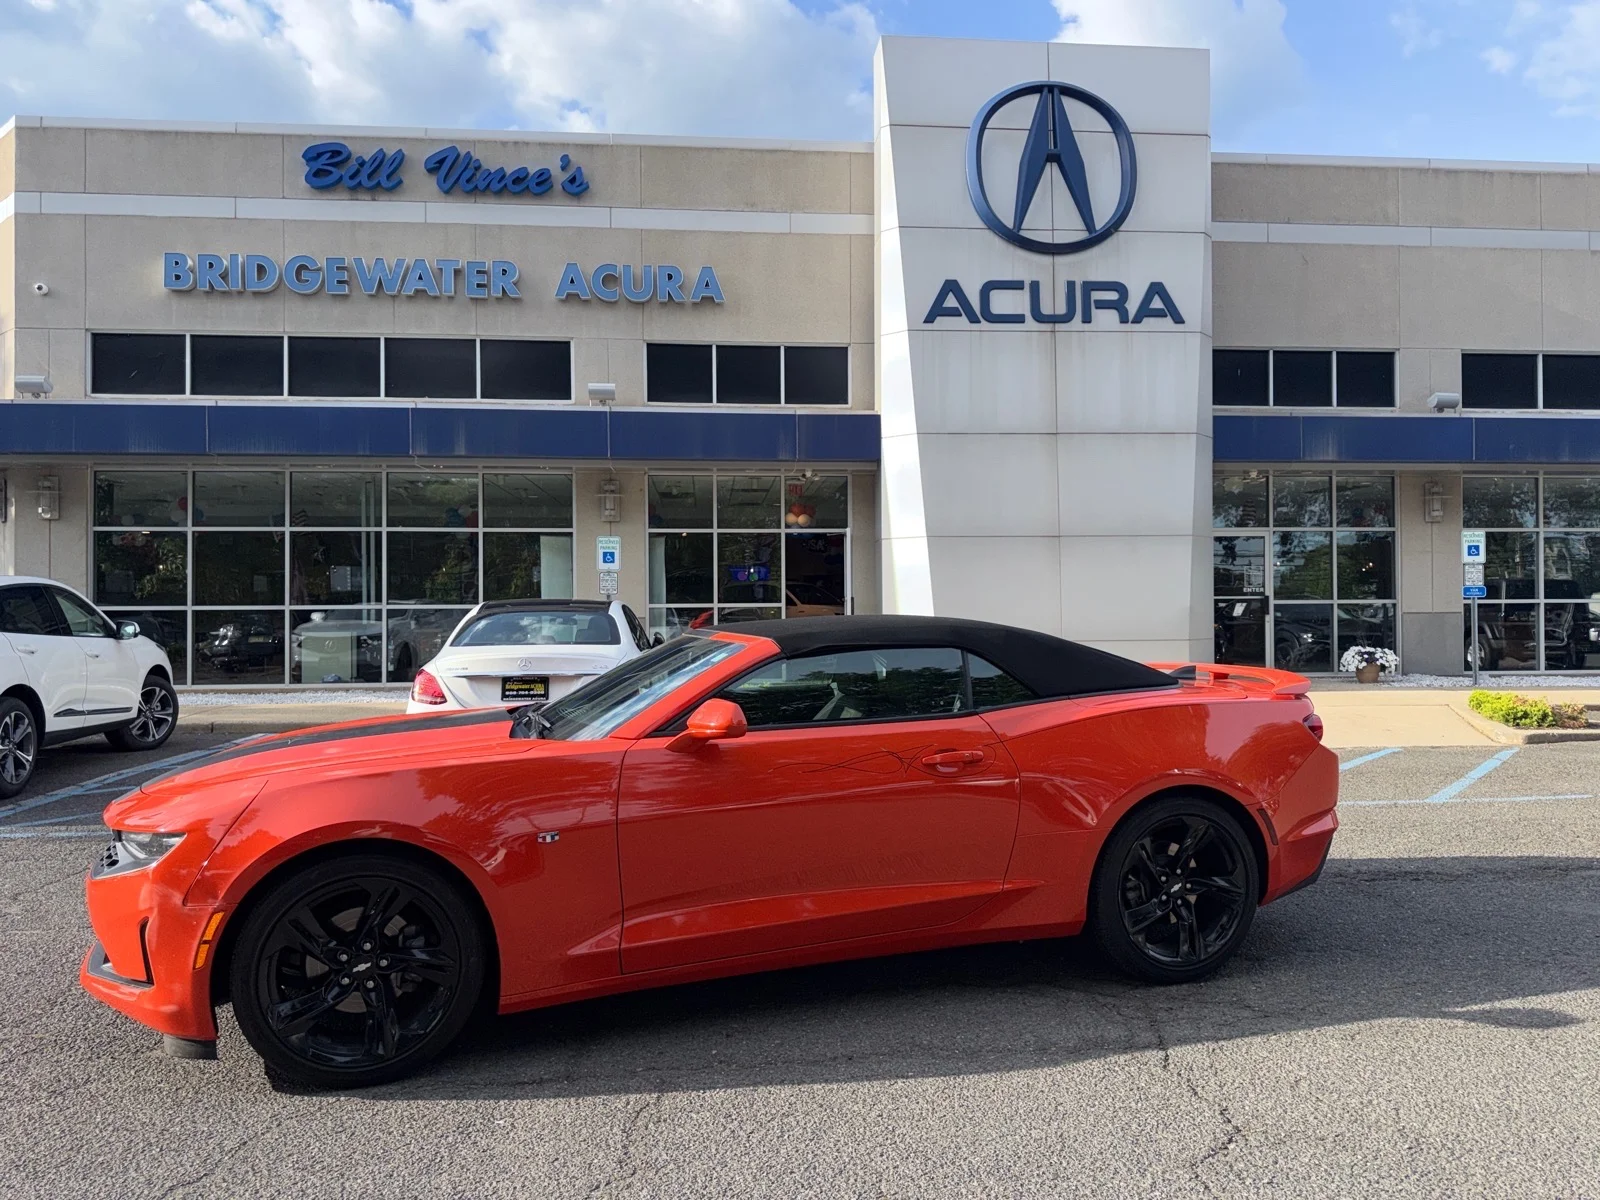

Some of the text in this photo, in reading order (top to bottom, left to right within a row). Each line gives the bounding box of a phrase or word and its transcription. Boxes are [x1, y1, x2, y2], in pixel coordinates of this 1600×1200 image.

[302, 142, 590, 197] Bill Vince's
[163, 252, 727, 305] BRIDGEWATER ACURA
[922, 279, 1186, 324] ACURA
